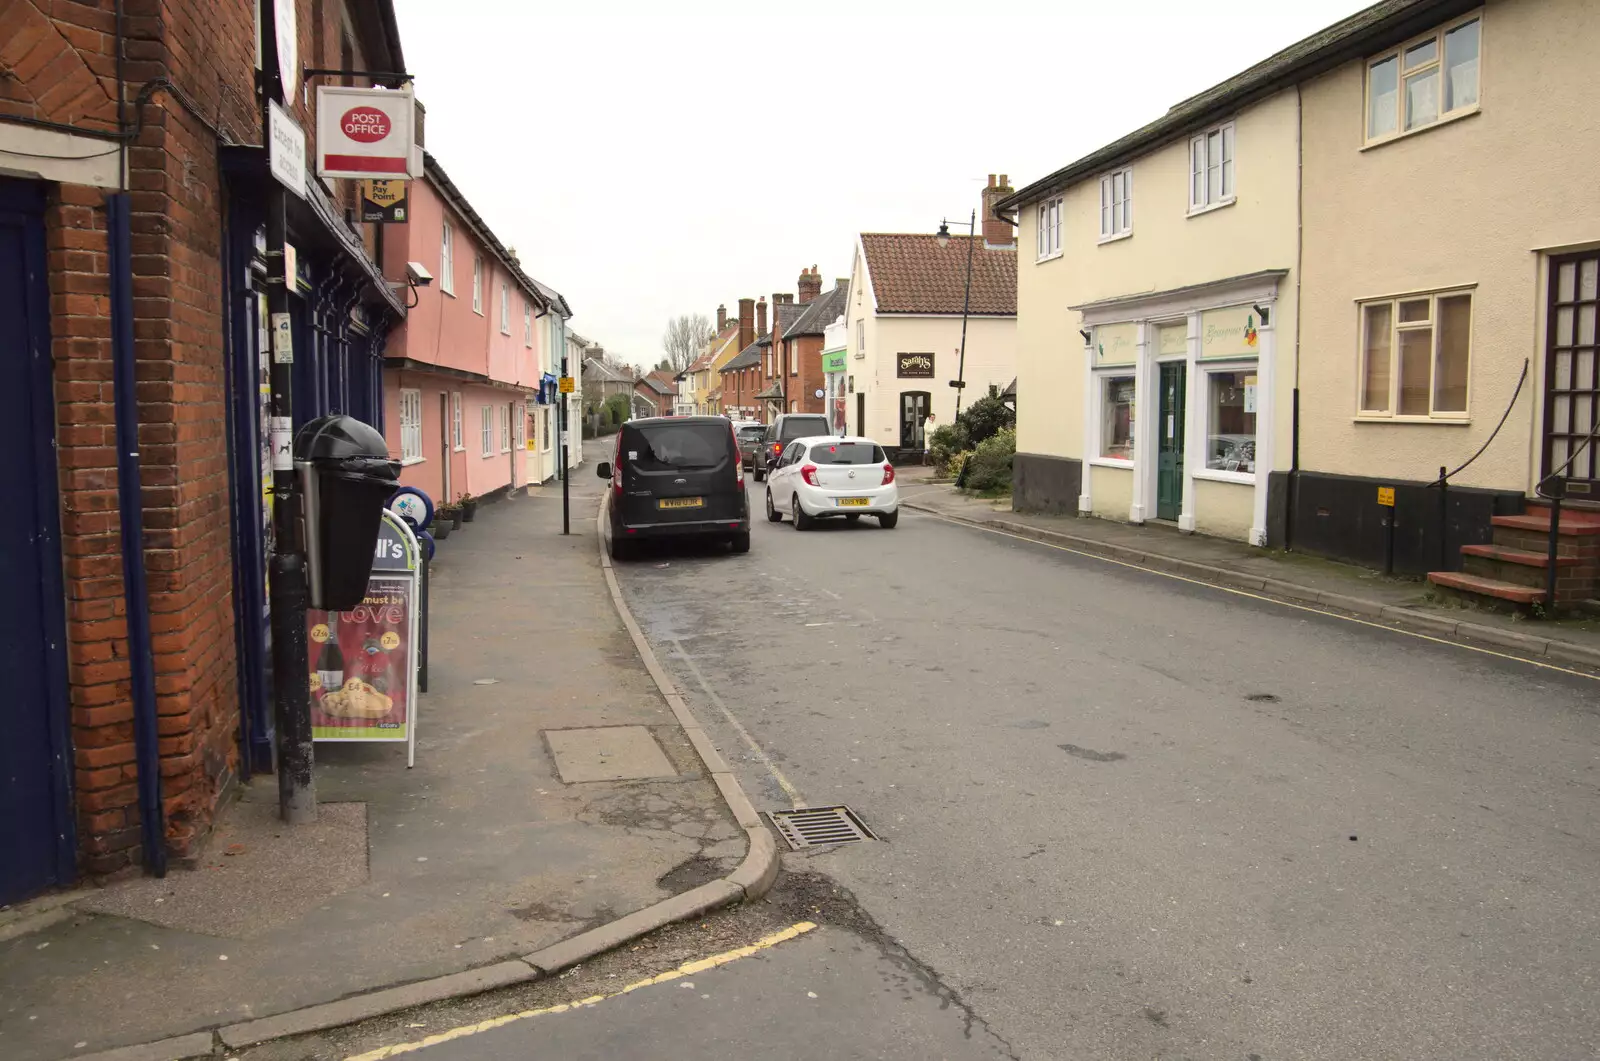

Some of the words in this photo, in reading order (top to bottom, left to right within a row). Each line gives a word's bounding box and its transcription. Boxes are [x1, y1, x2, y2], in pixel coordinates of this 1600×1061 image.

[351, 113, 382, 124] POST
[344, 123, 386, 135] OFFICE
[372, 185, 388, 194] Pay
[372, 192, 396, 200] Point
[901, 355, 931, 370] Sarah's
[362, 595, 389, 605] must
